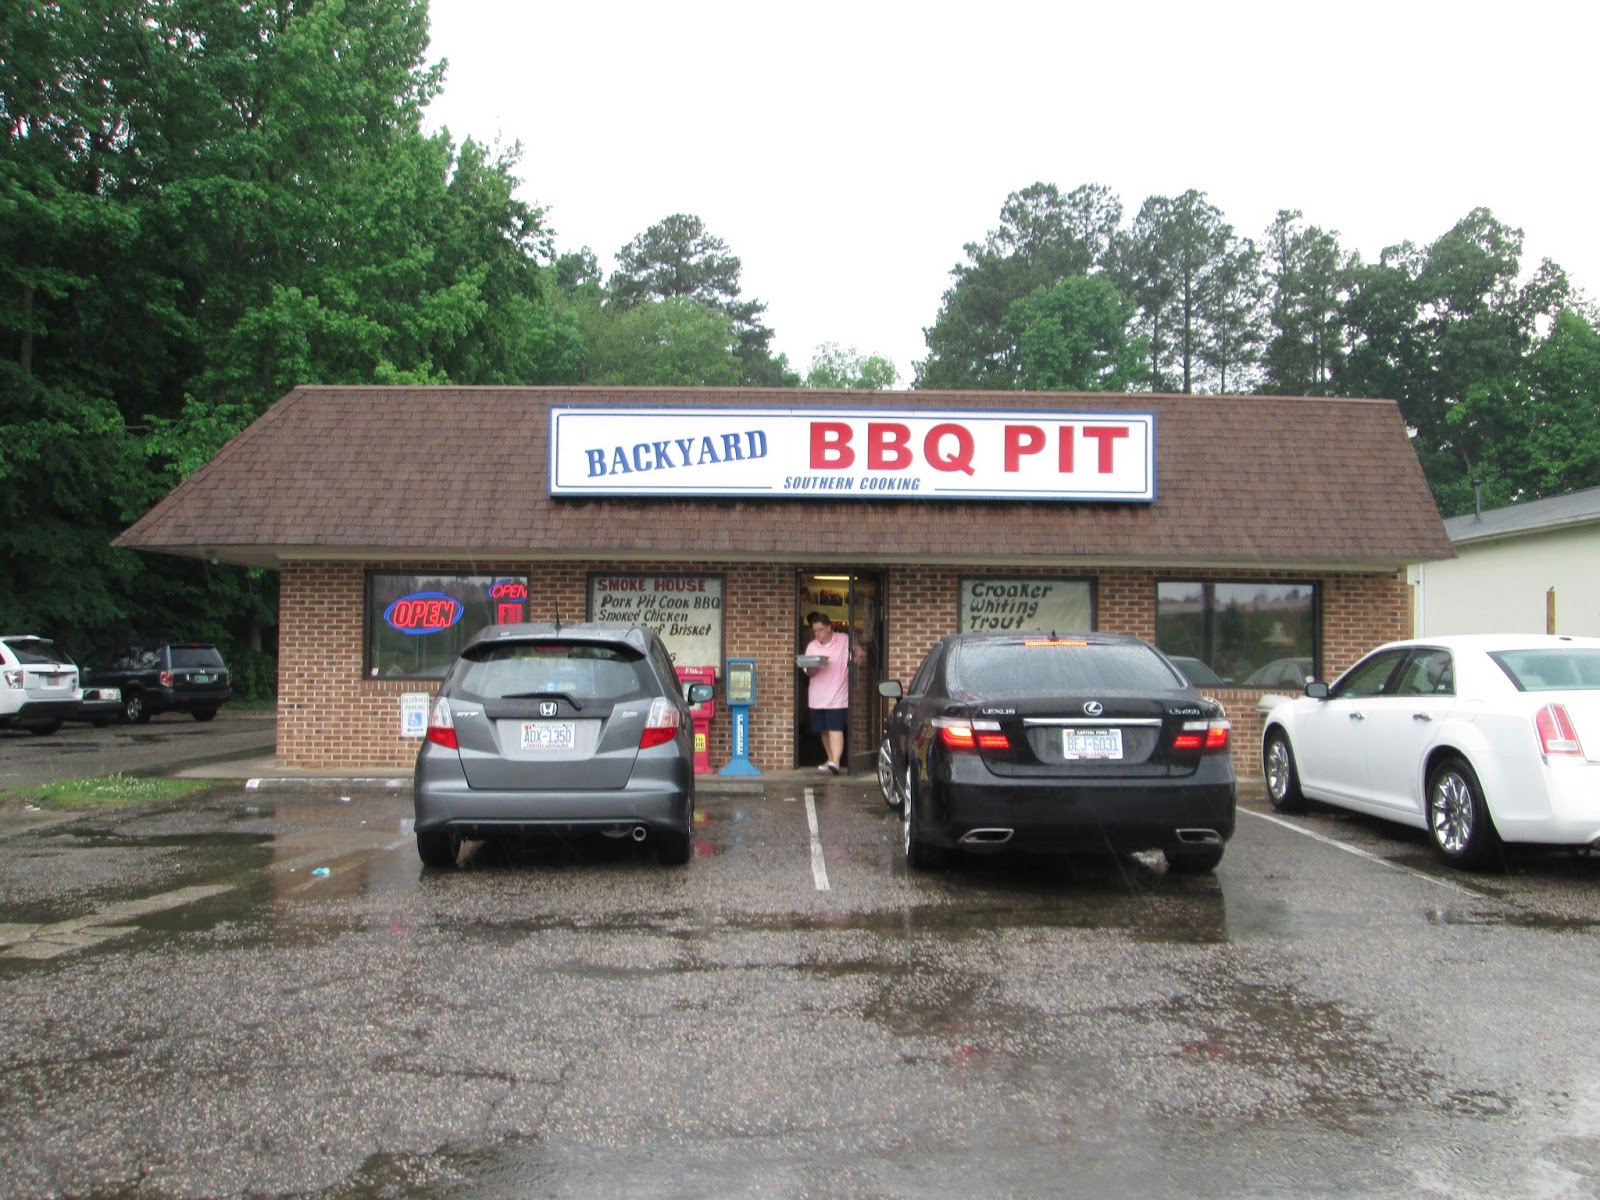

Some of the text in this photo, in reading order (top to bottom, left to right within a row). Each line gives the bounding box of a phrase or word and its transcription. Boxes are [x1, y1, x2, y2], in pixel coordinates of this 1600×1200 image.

[585, 421, 1130, 478] BACKYARD BBQ PIT
[783, 476, 921, 491] SOUTHERN COOKING
[492, 584, 528, 598] OPEN
[598, 579, 706, 592] SMOKE HOUSE
[971, 583, 1053, 598] Croaker
[600, 594, 720, 609] Pork Pit Cook BBQ
[970, 599, 1039, 618] Whiting
[393, 600, 455, 627] OPEN
[598, 609, 688, 623] Smoked Chicken
[970, 615, 1025, 629] Trout
[670, 624, 711, 636] Brisket
